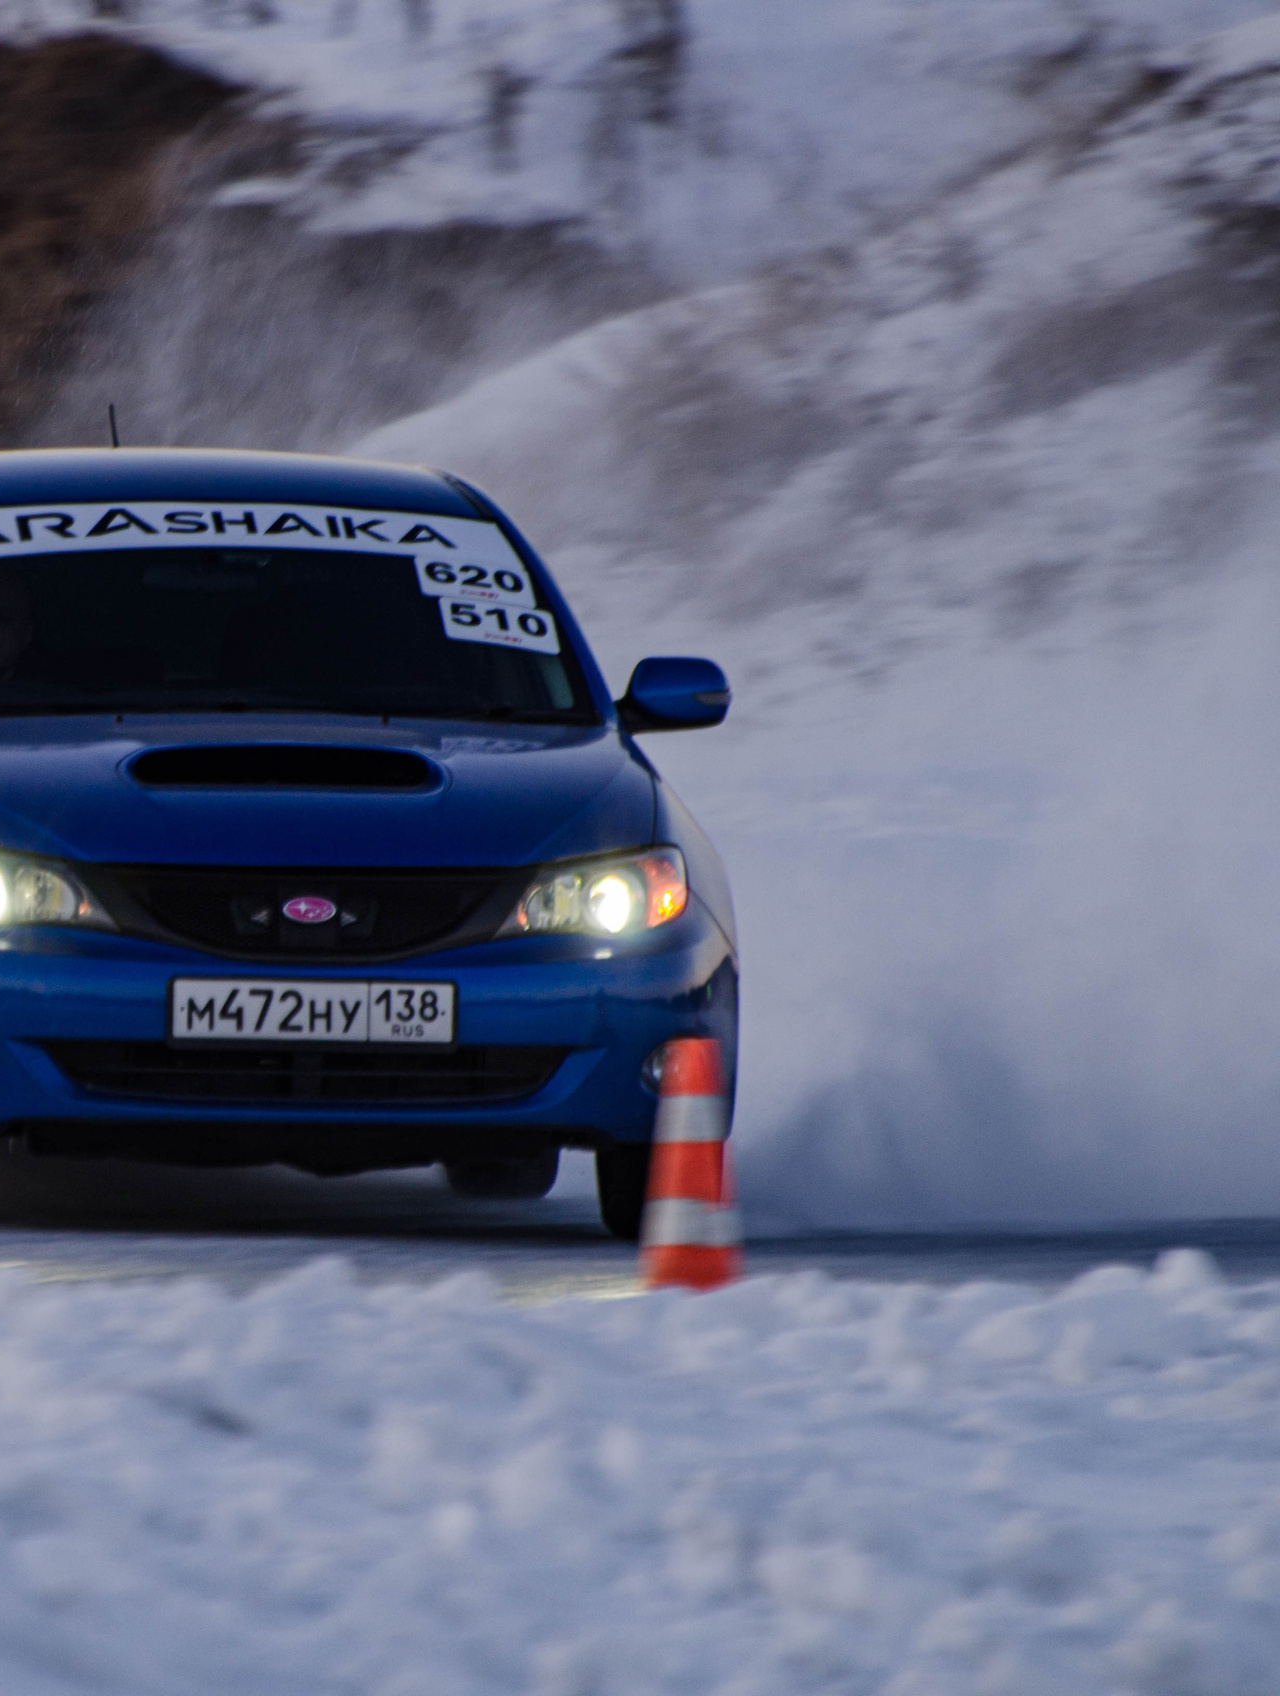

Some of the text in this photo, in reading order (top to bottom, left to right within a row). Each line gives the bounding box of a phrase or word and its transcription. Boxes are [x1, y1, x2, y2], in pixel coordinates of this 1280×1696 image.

[424, 561, 524, 593] 620
[450, 603, 548, 638] 510
[375, 989, 439, 1023] 138
[391, 1024, 424, 1038] RUS
